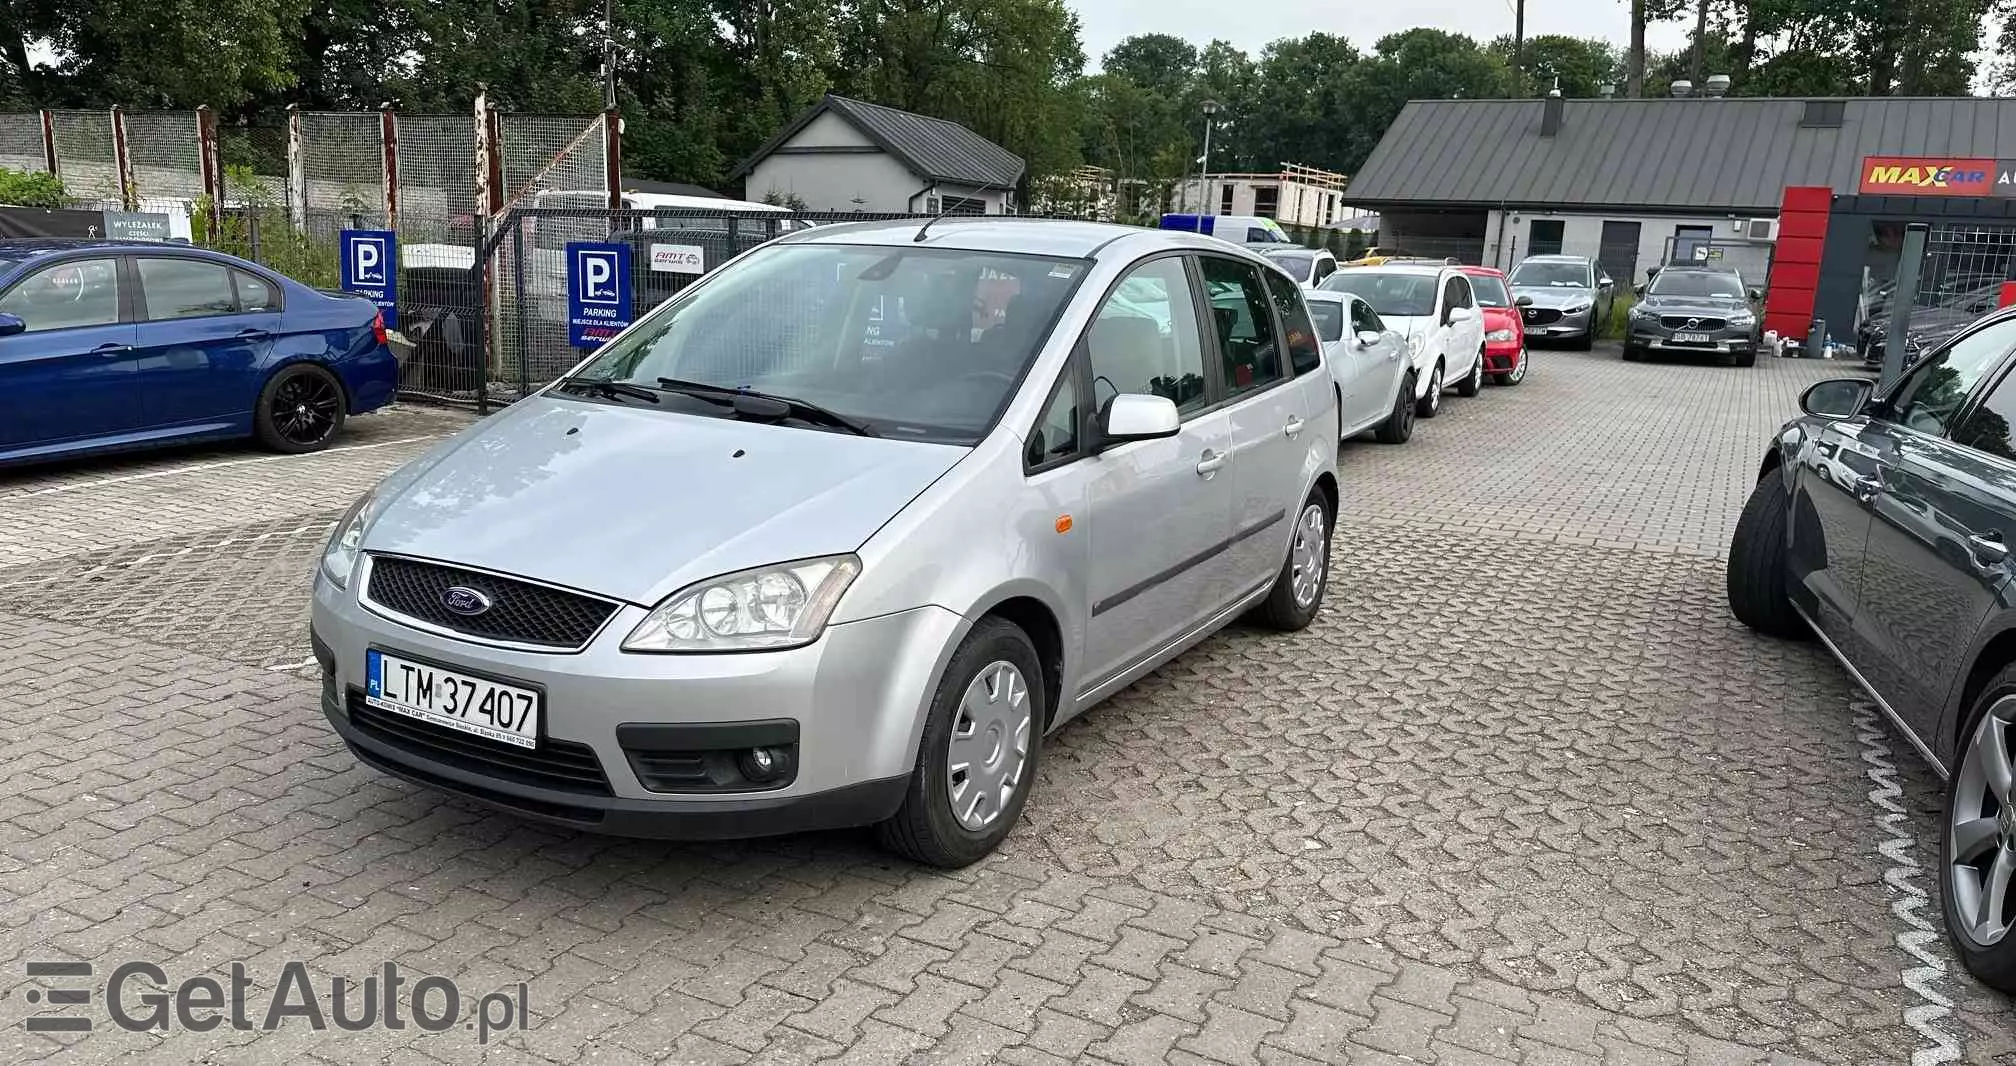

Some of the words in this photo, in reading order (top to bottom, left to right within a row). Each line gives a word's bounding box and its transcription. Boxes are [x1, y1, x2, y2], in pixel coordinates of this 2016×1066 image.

[1868, 166, 1954, 187] MAX
[1934, 170, 1986, 183] CAR
[358, 243, 378, 280] P
[586, 257, 610, 297] P
[583, 307, 617, 318] PARKING
[448, 591, 474, 608] Ford
[370, 679, 380, 690] PL
[384, 659, 433, 709] LTM
[443, 676, 533, 732] 37407
